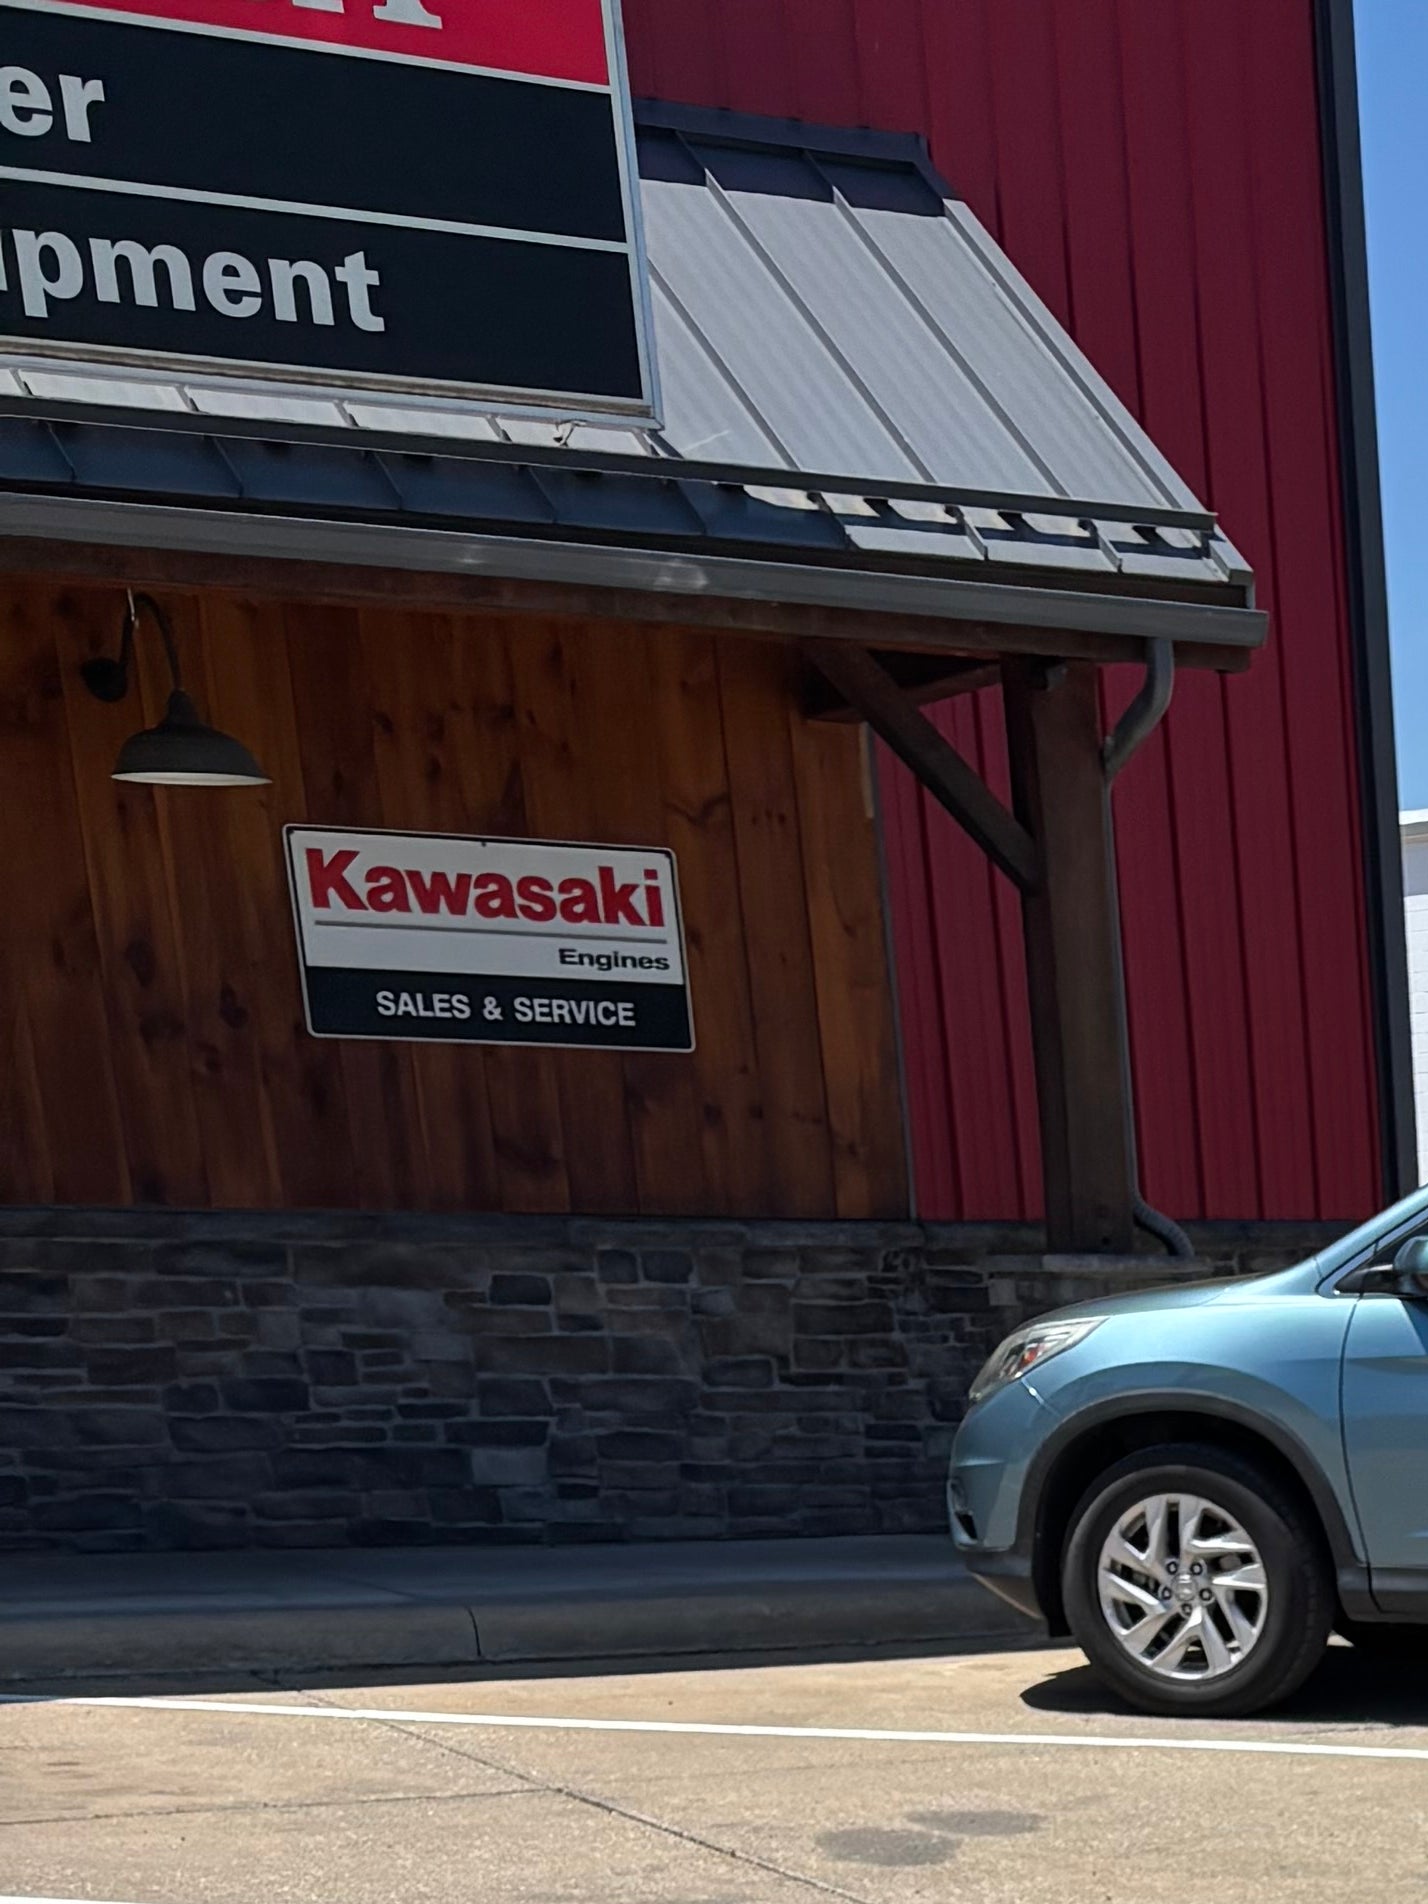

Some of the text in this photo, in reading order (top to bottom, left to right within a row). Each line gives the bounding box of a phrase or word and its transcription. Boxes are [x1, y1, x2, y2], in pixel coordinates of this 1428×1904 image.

[305, 847, 665, 928] Kawasaki
[558, 948, 670, 972] Engines
[376, 990, 636, 1027] SALES & SERVICE
